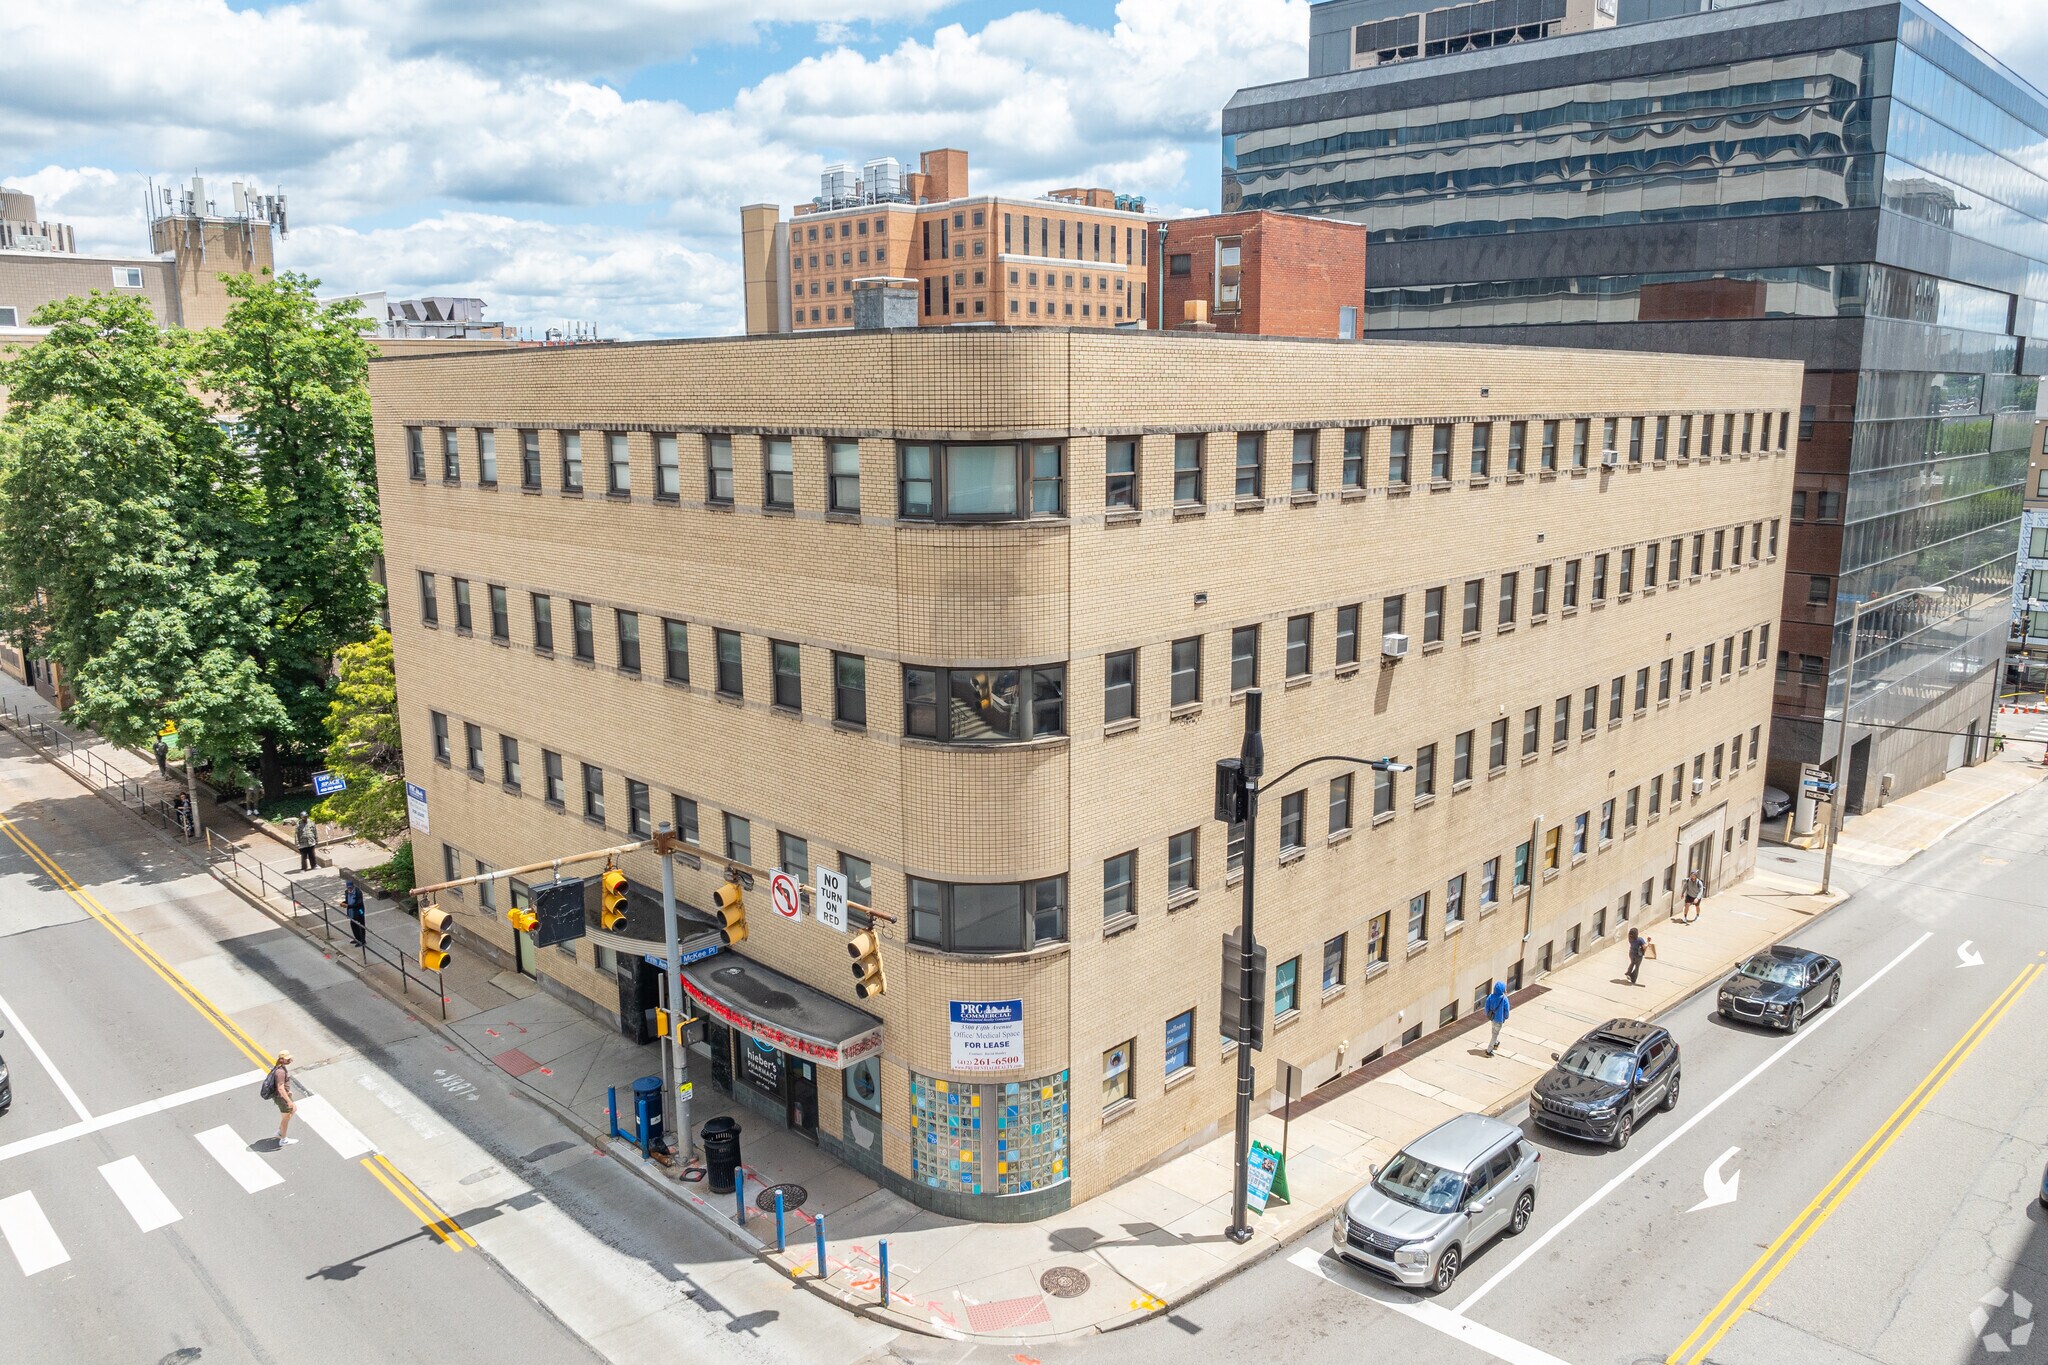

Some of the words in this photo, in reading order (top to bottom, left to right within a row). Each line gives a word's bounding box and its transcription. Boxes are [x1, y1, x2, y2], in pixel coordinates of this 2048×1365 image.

[824, 873, 838, 889] NO
[821, 887, 842, 903] TURN
[826, 901, 837, 913] ON
[823, 911, 839, 925] RED
[683, 950, 707, 962] McKee
[708, 946, 716, 955] Pl
[960, 1003, 983, 1014] PRC
[1002, 1031, 1020, 1039] Space
[1167, 1022, 1186, 1034] wellness
[747, 1047, 777, 1073] hieber's
[974, 1056, 1018, 1065] 261-6500
[747, 1060, 777, 1081] PHARMACY
